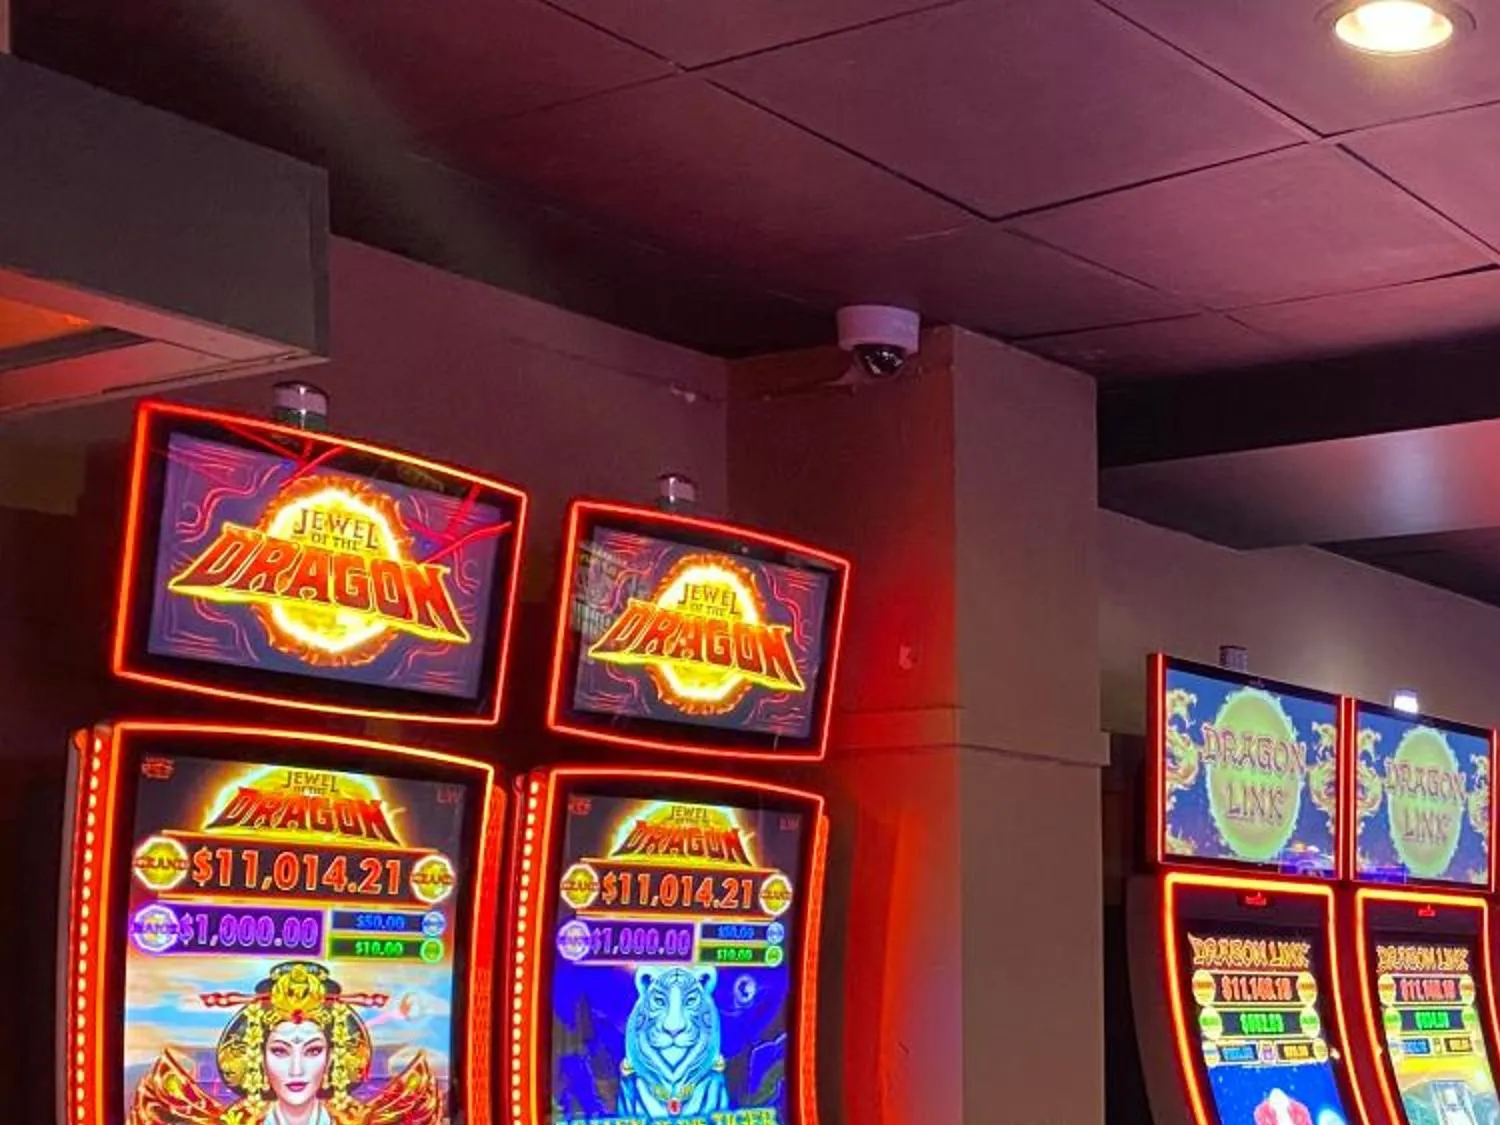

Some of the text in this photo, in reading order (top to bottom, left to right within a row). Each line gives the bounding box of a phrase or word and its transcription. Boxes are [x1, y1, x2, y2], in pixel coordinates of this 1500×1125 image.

[293, 508, 379, 549] JEWEL
[311, 532, 360, 550] OF THE
[169, 521, 470, 643] DRAGON
[677, 582, 740, 615] JEWEL
[588, 597, 805, 691] DRAGON
[1201, 722, 1308, 775] DRAGON
[284, 770, 339, 793] JEWEL
[1383, 757, 1469, 800] DRAGON
[203, 786, 405, 849] DRAGON
[671, 805, 708, 819] JEWEL
[1224, 782, 1284, 822] LINK
[609, 818, 755, 868] DRAGON
[1402, 811, 1451, 845] LINK
[191, 847, 400, 895] $11,014.21
[601, 870, 754, 909] $11,014.21
[178, 912, 319, 949] $1,000.00
[591, 926, 691, 956] $1,000.00
